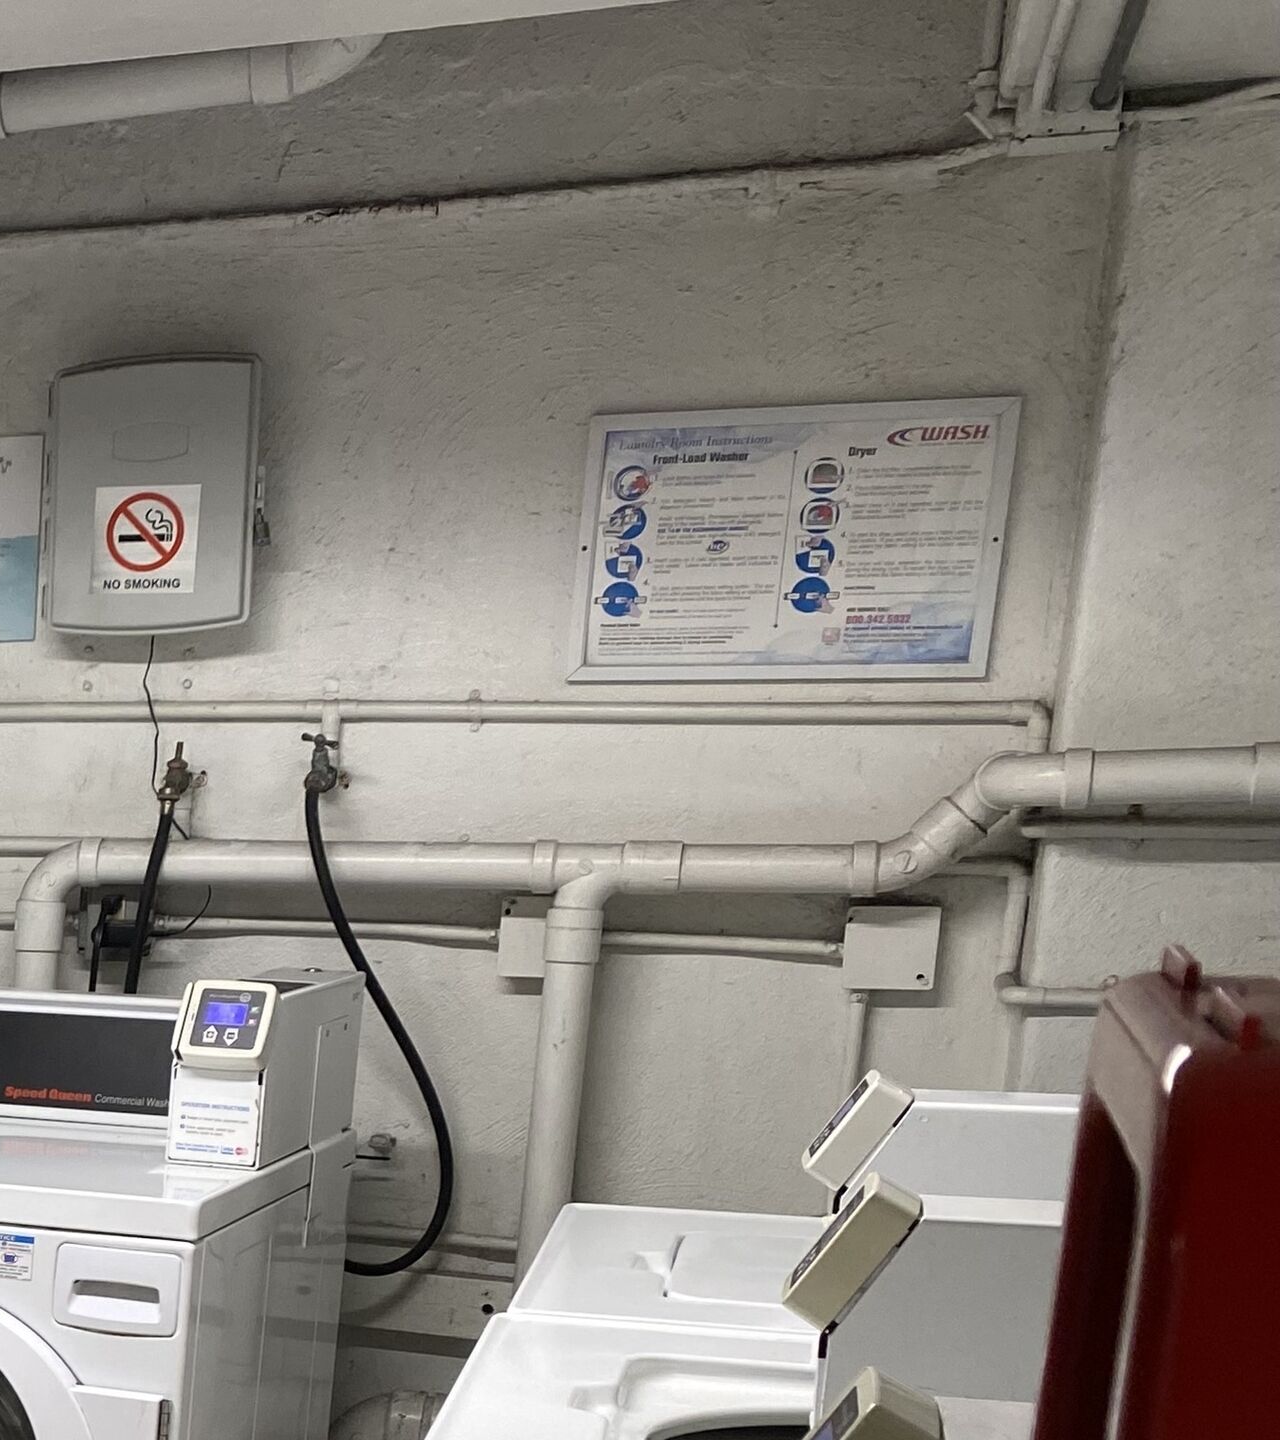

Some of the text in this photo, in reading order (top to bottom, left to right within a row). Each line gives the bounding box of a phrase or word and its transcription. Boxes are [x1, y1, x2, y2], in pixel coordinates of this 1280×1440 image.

[920, 424, 990, 441] WASH
[706, 434, 773, 447] Instructions
[653, 451, 750, 465] Front-Load Washer
[848, 446, 878, 459] Dryer
[103, 578, 181, 590] NO SMOKING
[4, 1085, 169, 1108] Speed Queen Commercial Wash
